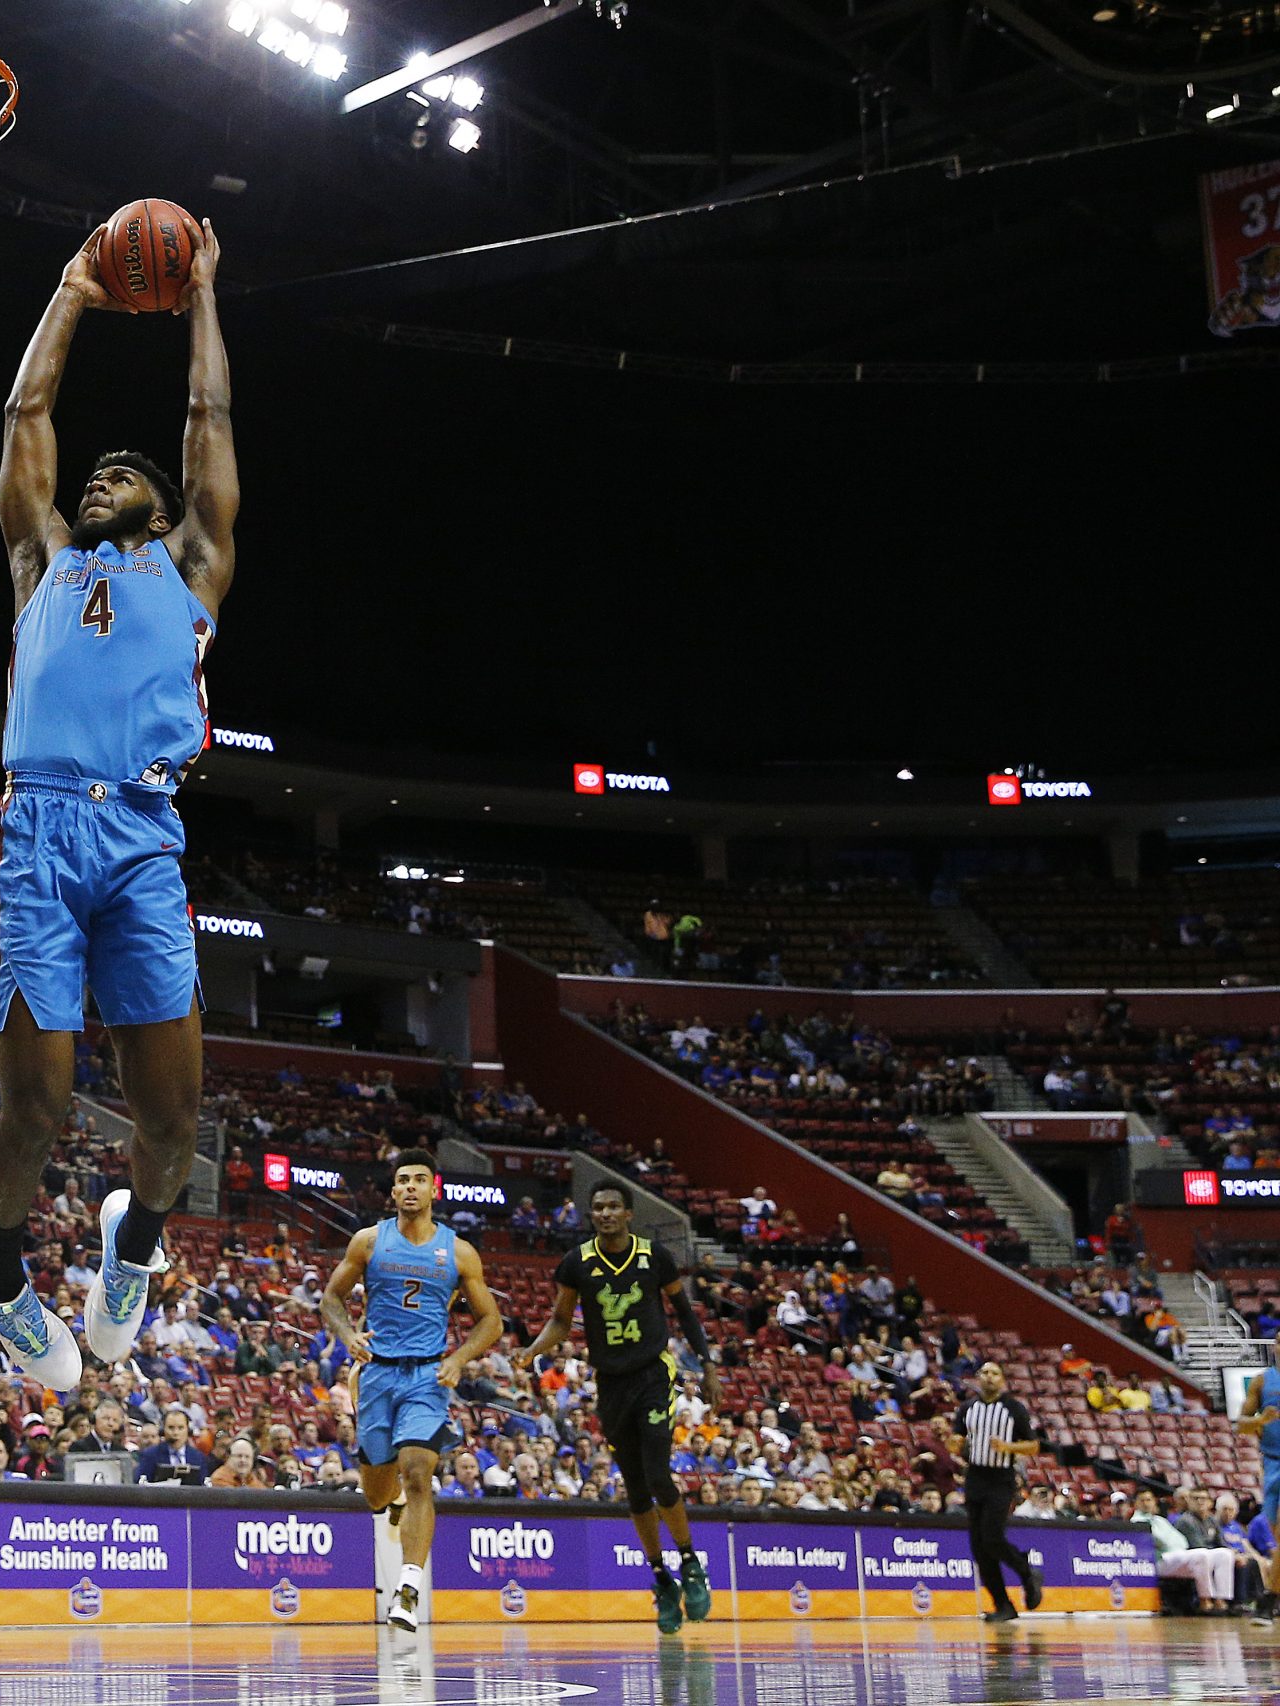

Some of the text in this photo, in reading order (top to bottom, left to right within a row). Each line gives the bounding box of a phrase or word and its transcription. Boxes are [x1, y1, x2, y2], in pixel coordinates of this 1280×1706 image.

[124, 216, 150, 294] Wilson
[160, 220, 181, 279] NCAA
[81, 577, 116, 637] 4
[212, 728, 275, 752] TOYOTA
[605, 773, 670, 792] TOYOTA
[1021, 782, 1092, 798] TOYOTA
[196, 915, 264, 939] TOYOTA
[442, 1182, 506, 1205] TOYOTA
[402, 1278, 423, 1310] 2
[605, 1318, 642, 1346] 24
[8, 1515, 159, 1543] Ambetter from
[234, 1514, 333, 1570] metro
[0, 1544, 169, 1571] Sunshine Health
[468, 1520, 555, 1574] metro
[746, 1545, 848, 1571] Florida Lottery
[893, 1536, 939, 1557] Greater
[1087, 1538, 1137, 1558] Coca-Cola
[864, 1556, 974, 1578] Ft. Lauderdale CVB
[1072, 1556, 1121, 1580] Beverages
